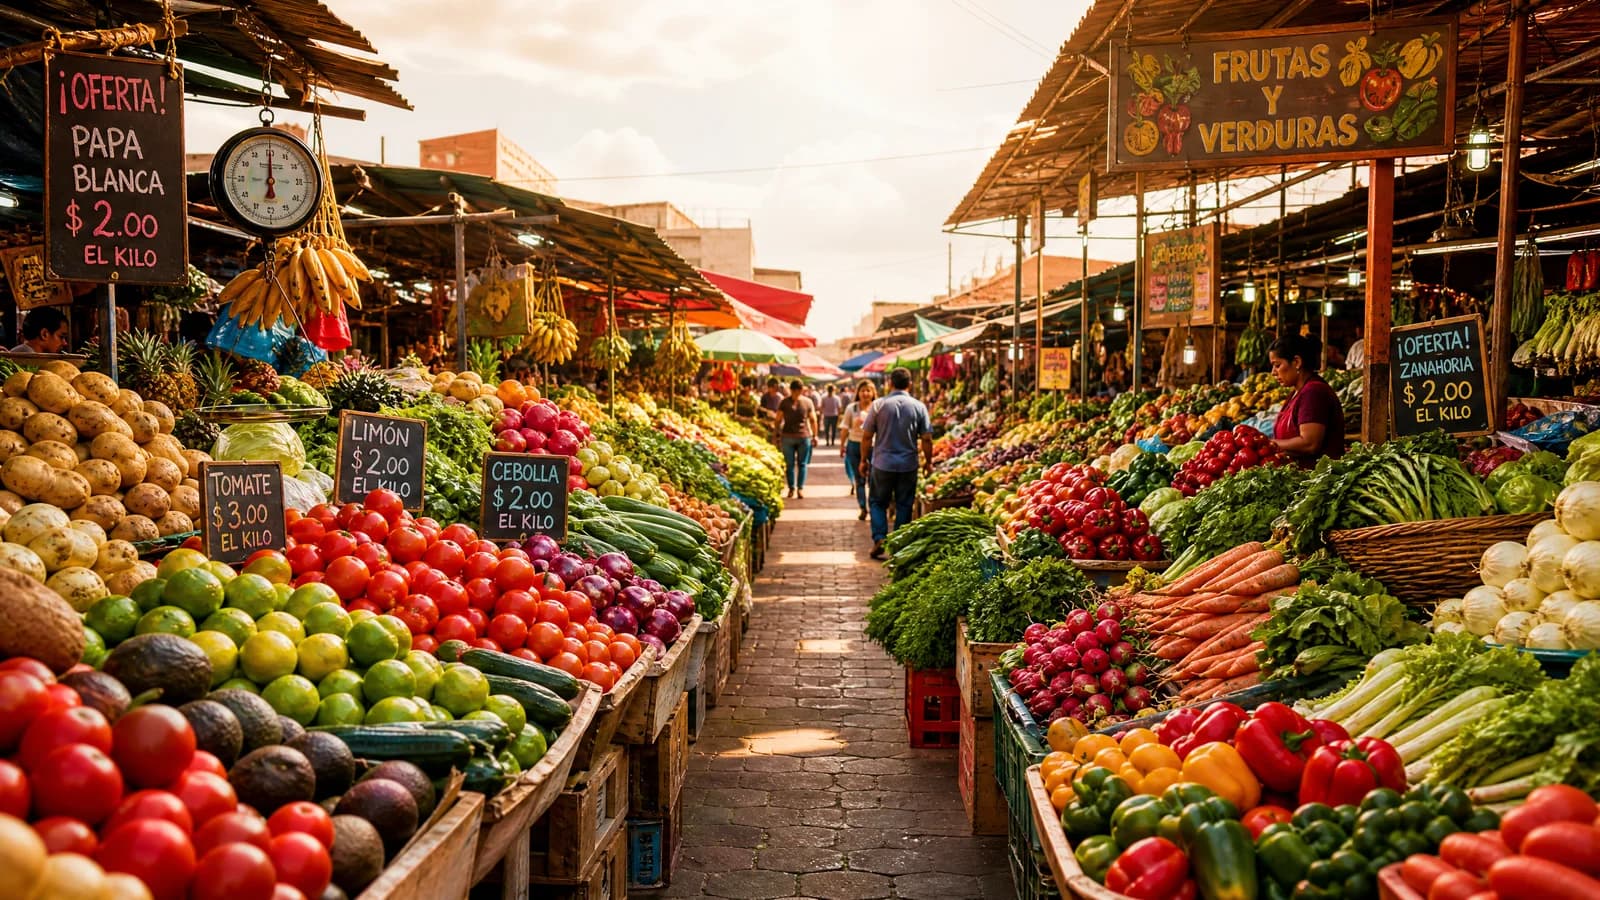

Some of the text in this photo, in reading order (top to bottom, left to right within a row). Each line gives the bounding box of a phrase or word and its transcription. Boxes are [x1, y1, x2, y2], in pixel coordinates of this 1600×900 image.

[1213, 43, 1331, 84] FRUTAS
[59, 70, 166, 115] ¡OFERTA!
[1261, 85, 1284, 115] Y
[71, 124, 144, 160] PAPA
[1198, 113, 1359, 154] VERDURAS
[72, 163, 165, 196] BLANCA
[84, 244, 158, 267] EL KILO
[1396, 325, 1470, 360] ¡OFERTA!
[1399, 355, 1475, 379] ZANAHORIA
[1415, 405, 1472, 423] EL KILO
[209, 471, 272, 497] TOMATE
[352, 476, 371, 494] EL
[491, 461, 560, 484] CEBOLLA
[498, 513, 554, 529] EL KILO
[221, 529, 272, 552] EL KILO
